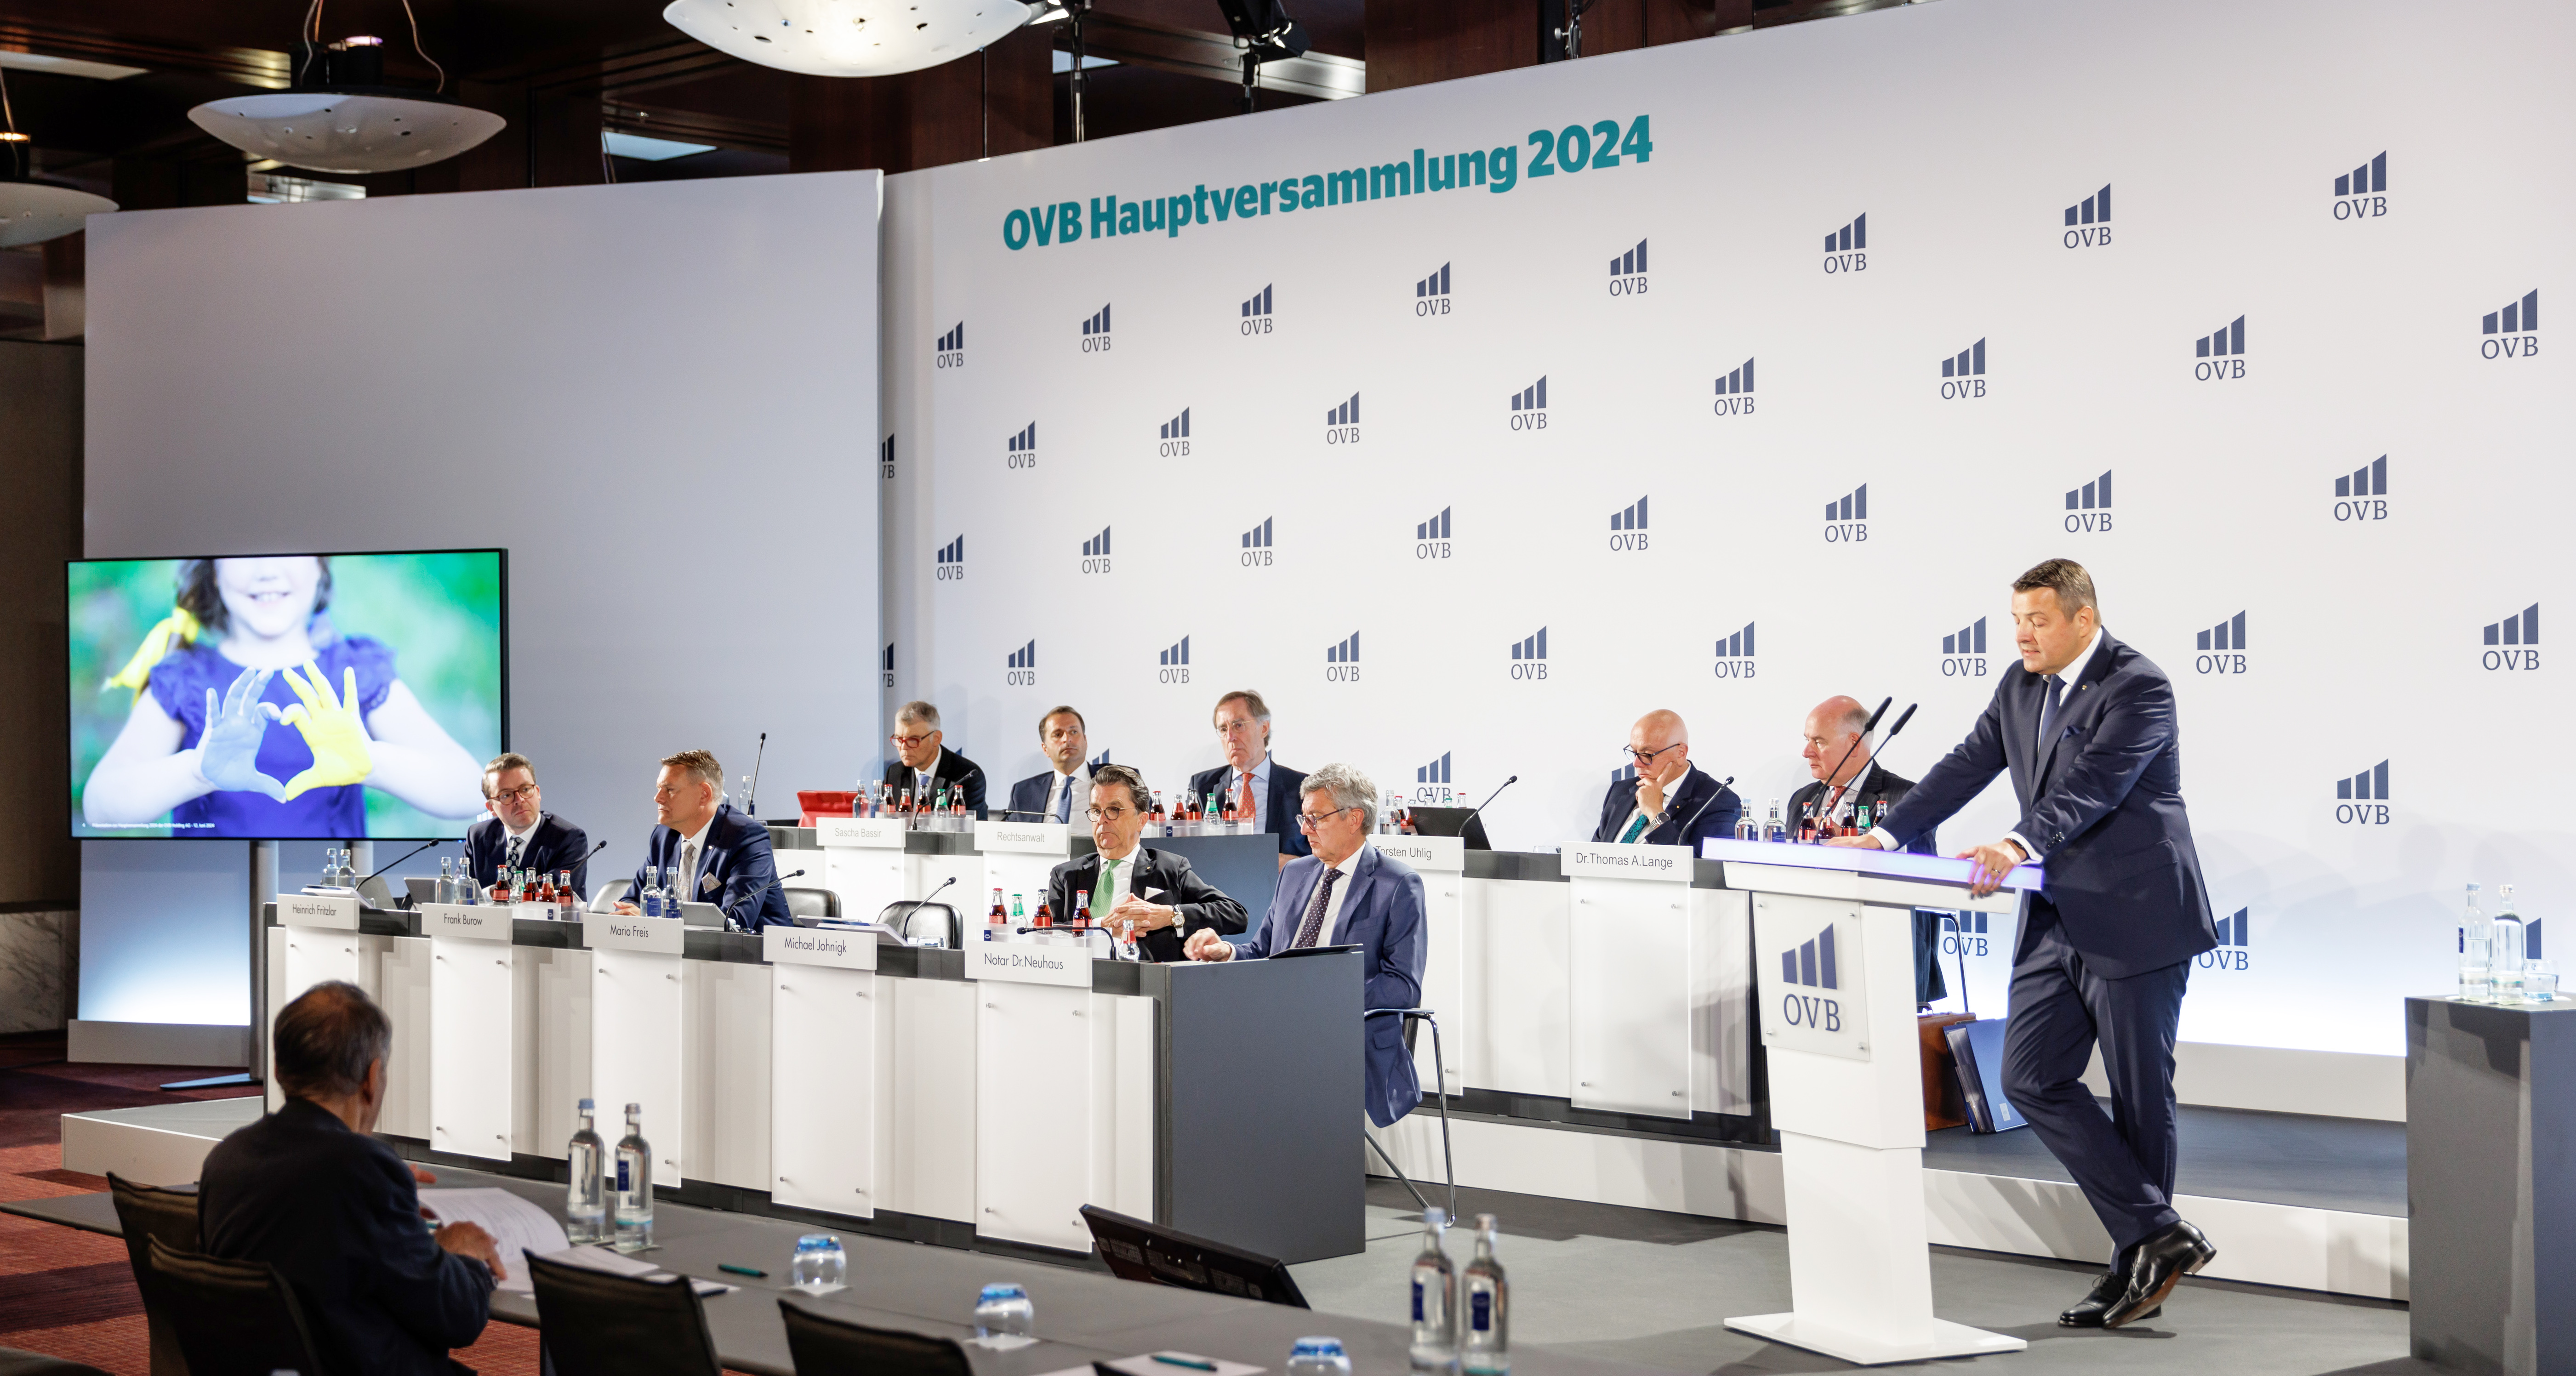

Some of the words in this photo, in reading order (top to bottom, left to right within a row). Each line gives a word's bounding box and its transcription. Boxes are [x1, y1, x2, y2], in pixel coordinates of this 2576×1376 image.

[1003, 201, 1082, 250] OVB
[1090, 145, 1517, 239] Hauptversammlung
[1527, 114, 1653, 178] 2024
[2333, 197, 2387, 220] OVB
[2064, 227, 2111, 249] OVB
[1824, 253, 1866, 274] OVB
[1609, 277, 1647, 296] OVB
[1416, 298, 1451, 317] OVB
[1241, 318, 1272, 335] OVB
[1082, 336, 1111, 353] OVB
[2481, 336, 2538, 359] OVB
[937, 353, 963, 369] OVB
[2195, 359, 2245, 381] OVB
[1941, 379, 1986, 400] OVB
[1714, 397, 1755, 416] OVB
[1510, 413, 1547, 431] OVB
[1327, 427, 1360, 444] OVB
[1160, 441, 1190, 457] OVB
[1008, 453, 1035, 469] OVB
[2334, 500, 2388, 521] OVB
[2064, 513, 2112, 533] OVB
[1610, 534, 1648, 551] OVB
[1825, 524, 1867, 543] OVB
[1242, 551, 1272, 567] OVB
[1416, 542, 1451, 559] OVB
[937, 566, 963, 580] OVB
[1082, 558, 1111, 574] OVB
[1715, 661, 1755, 678] OVB
[1942, 658, 1987, 677] OVB
[2196, 654, 2246, 674] OVB
[2482, 650, 2540, 671] OVB
[1008, 671, 1035, 685] OVB
[1159, 669, 1189, 683] OVB
[1327, 666, 1359, 682] OVB
[1511, 663, 1547, 680] OVB
[1416, 787, 1452, 803] OVB
[2336, 804, 2390, 824] OVB
[835, 827, 859, 837] Sascha
[861, 828, 882, 838] Bassir
[997, 831, 1045, 843] Rechtsanwalt
[1410, 847, 1431, 861] Uhlig
[1576, 852, 1629, 865] Dr.Thomas
[1631, 855, 1673, 870] A.Lange
[292, 903, 315, 915] Heinrich
[317, 904, 337, 916] Fritzlar
[444, 912, 461, 924] Frank
[463, 914, 483, 926] Burow
[610, 924, 631, 936] Mario
[633, 926, 649, 938] Freis
[784, 936, 815, 950] Michael
[816, 938, 847, 956] Johnigk
[1943, 936, 1989, 957] OVB
[984, 952, 1009, 966] Notar
[1012, 954, 1064, 970] Dr.Neuhaus
[2198, 950, 2249, 971] OVB
[1784, 994, 1841, 1032] OVB
